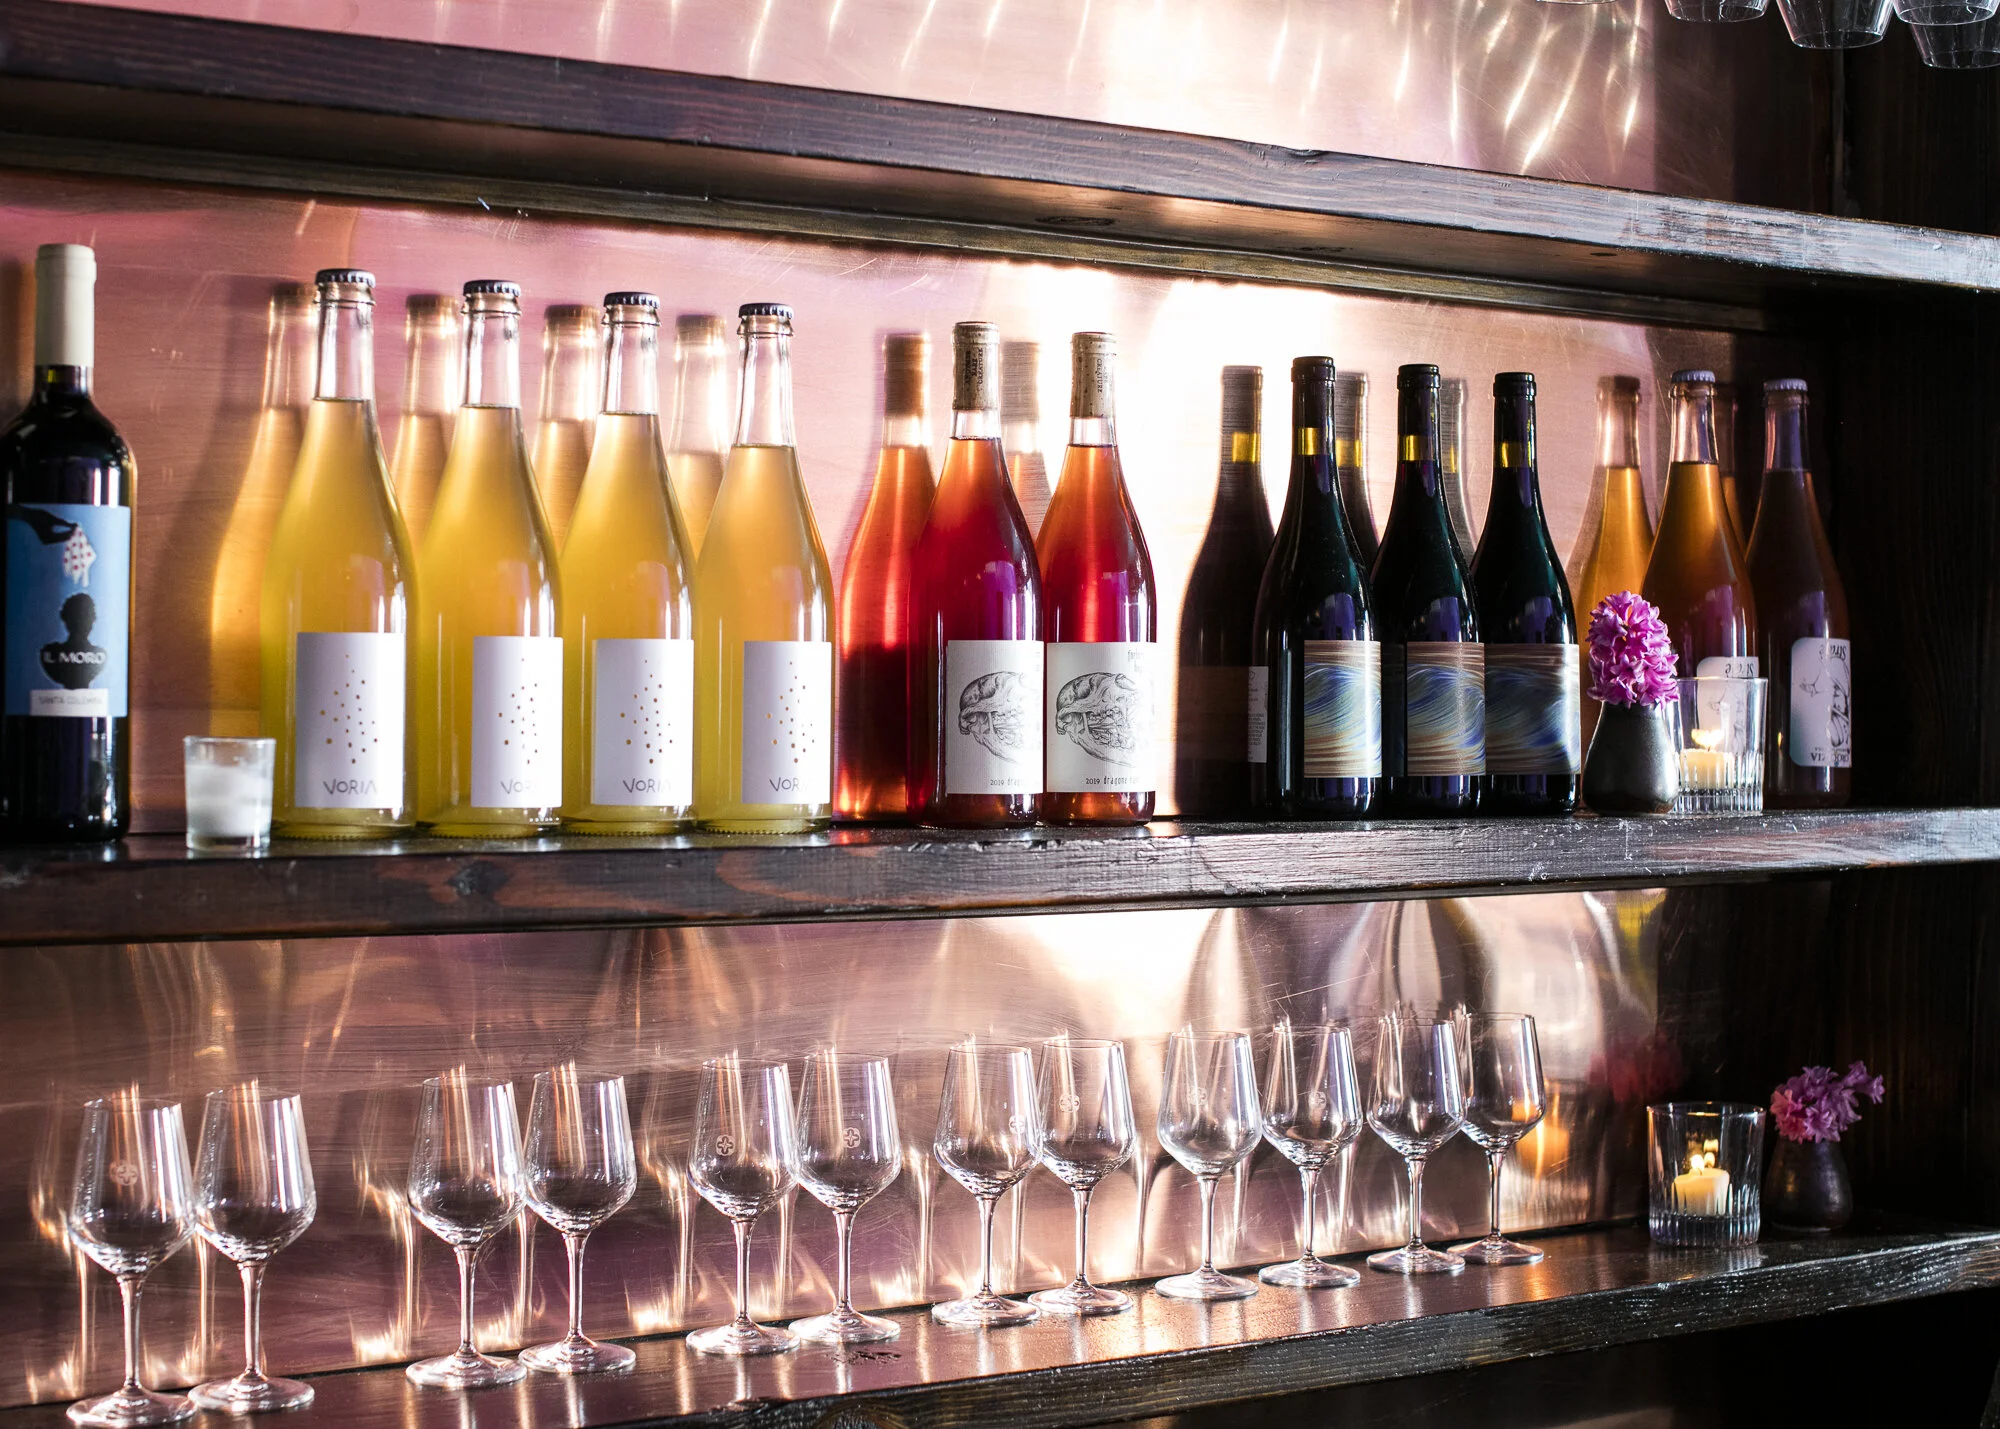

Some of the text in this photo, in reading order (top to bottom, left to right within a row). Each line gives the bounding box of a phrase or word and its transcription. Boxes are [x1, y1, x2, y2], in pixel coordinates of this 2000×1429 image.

[43, 651, 107, 664] IL MORO
[322, 778, 377, 795] VORIA
[768, 776, 802, 792] VOR
